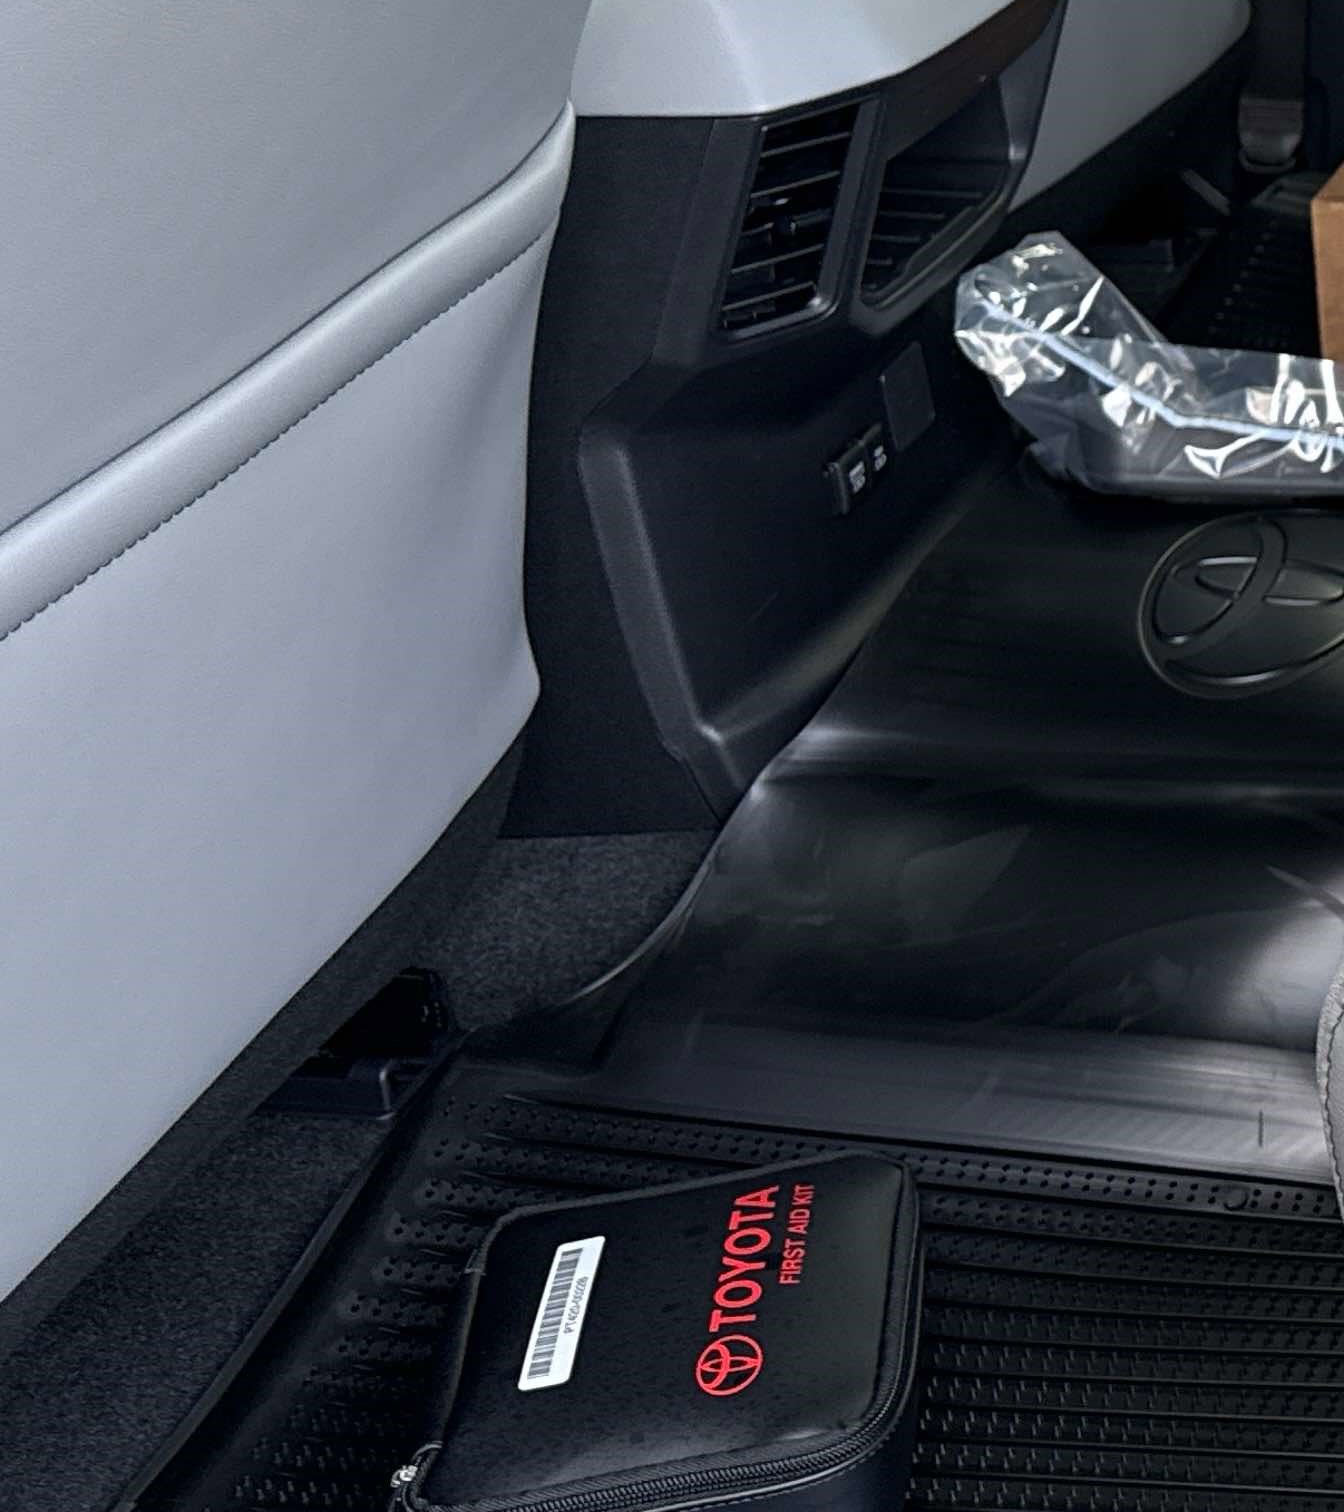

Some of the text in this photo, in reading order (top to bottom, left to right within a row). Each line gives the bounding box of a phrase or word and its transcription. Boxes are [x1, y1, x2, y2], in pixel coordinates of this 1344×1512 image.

[709, 1185, 779, 1333] TOYOTA
[779, 1184, 815, 1285] FIRST AID KIT
